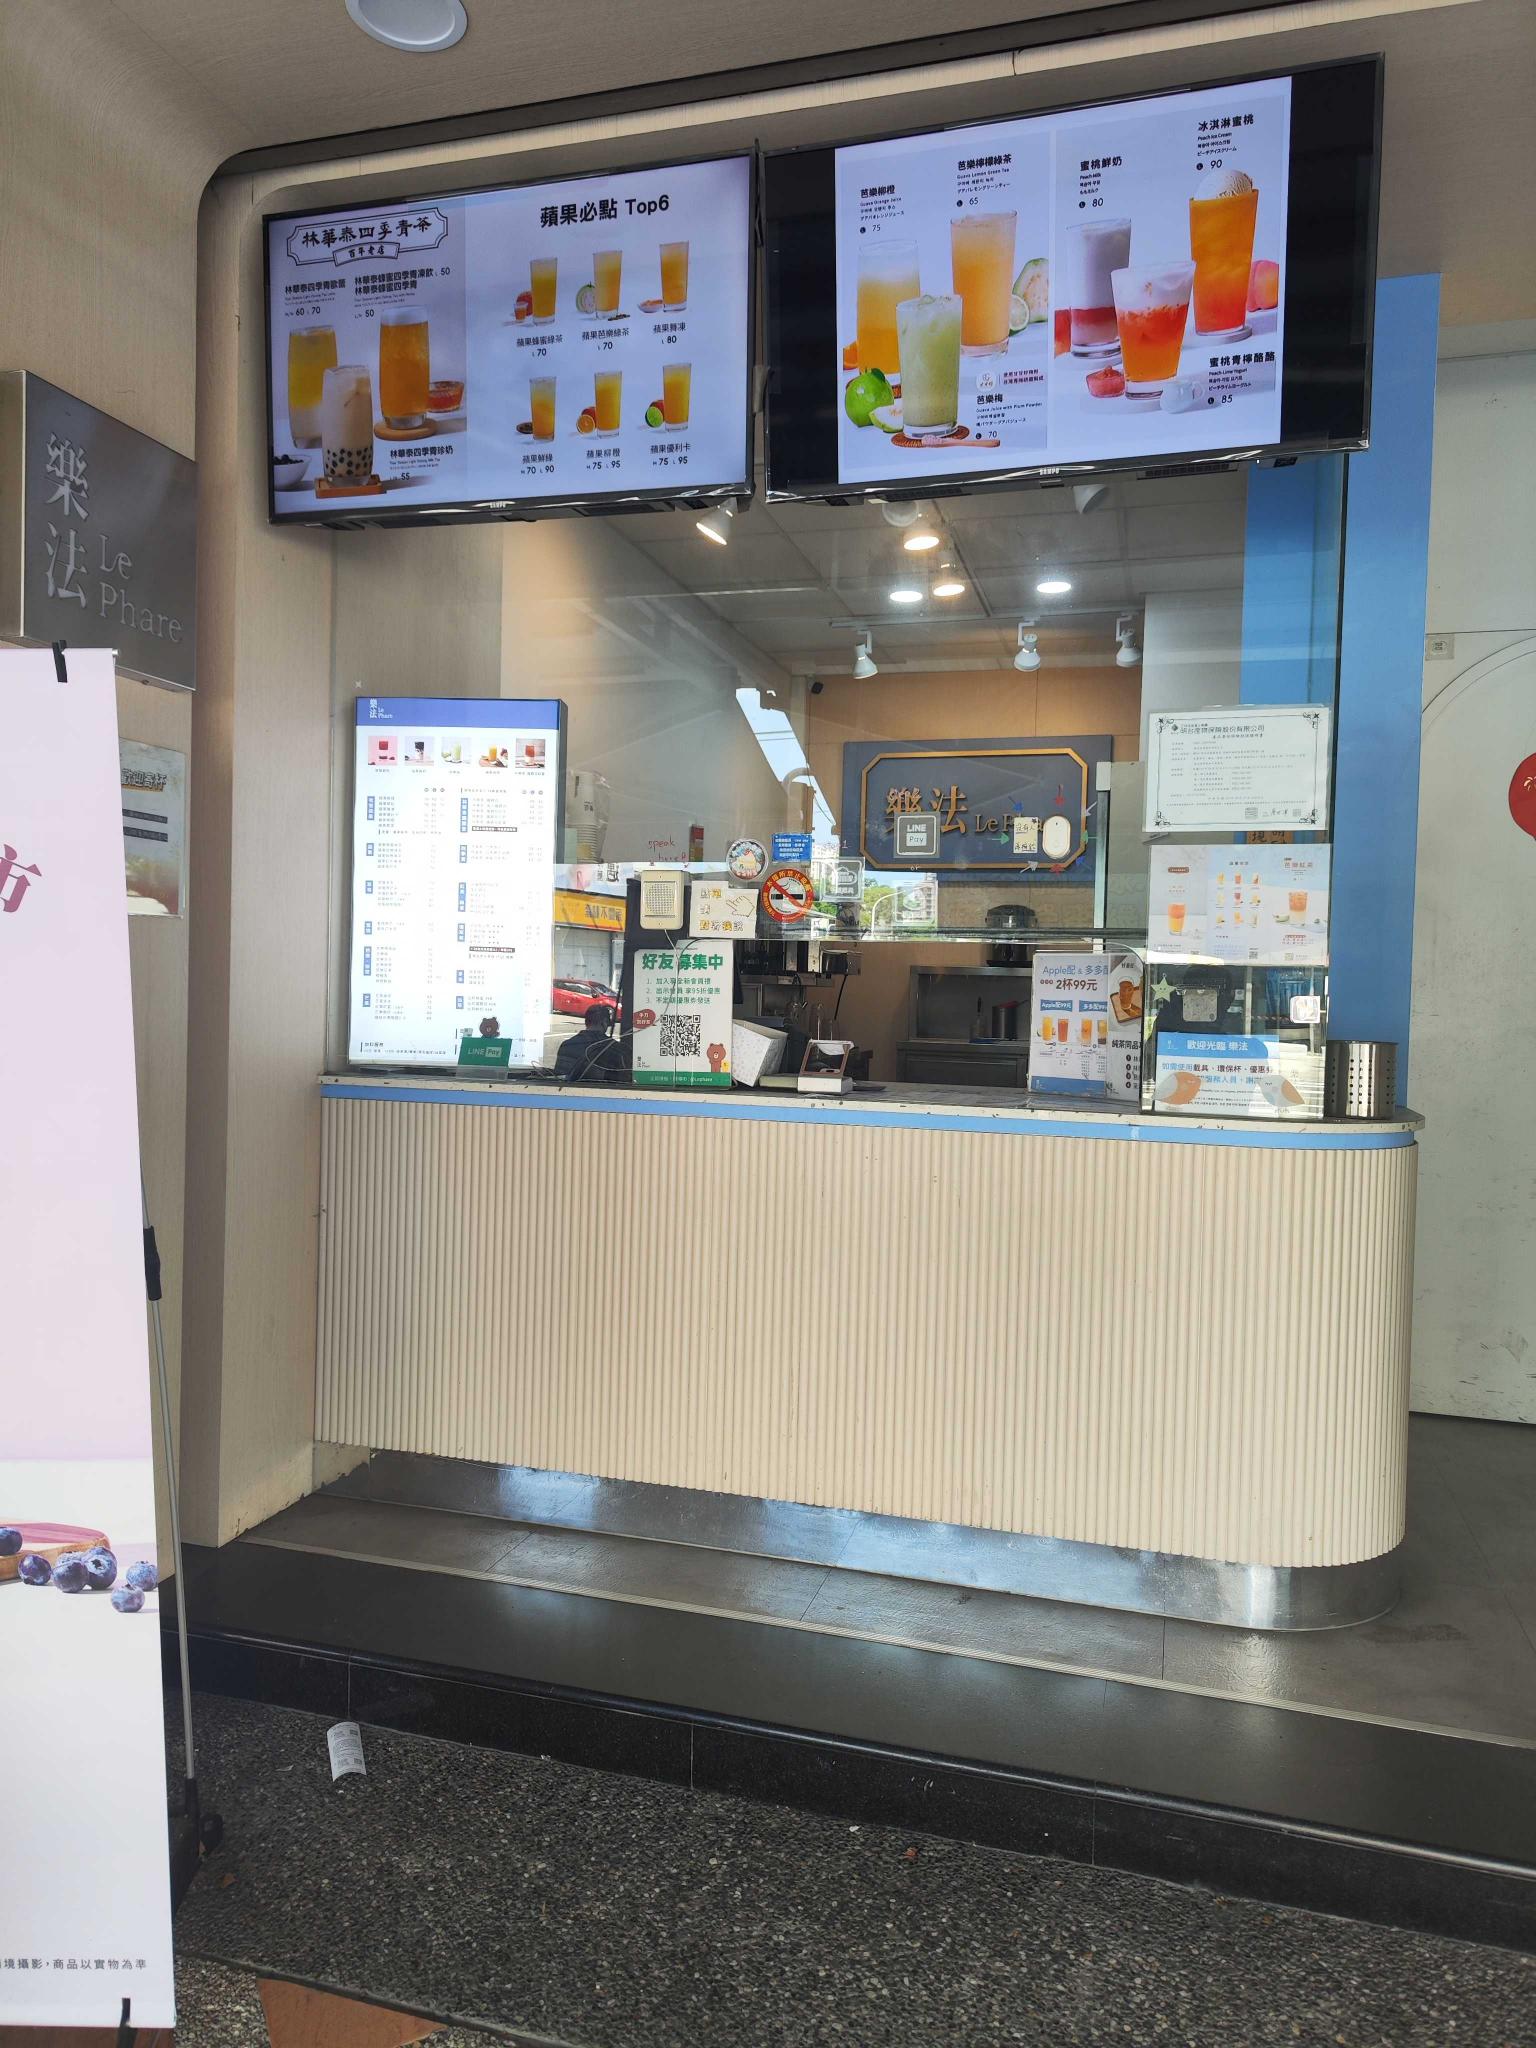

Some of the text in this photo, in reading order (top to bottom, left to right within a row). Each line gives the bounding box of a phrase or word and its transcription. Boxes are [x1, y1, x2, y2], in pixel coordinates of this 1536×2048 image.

[1198, 114, 1254, 132] 冰淇淋蜜桃
[958, 154, 1012, 171] 芭樂檸檬綠茶
[1080, 156, 1122, 171] 蜜桃鮮奶
[1210, 159, 1222, 169] 90
[860, 185, 895, 198] 芭樂柳橙
[969, 197, 979, 205] 65
[1092, 198, 1104, 207] 80
[540, 194, 669, 228] 蘋果必點 Top6
[302, 217, 432, 248] 林華泰四季青茶
[872, 224, 881, 232] 75
[349, 246, 384, 258] 百年老店
[441, 267, 450, 276] 50
[354, 279, 417, 296] 林華泰蜂蜜四季青
[296, 306, 320, 316] 60 70
[365, 309, 374, 318] 50
[582, 327, 630, 341] 蘋果芭樂綠茶
[667, 335, 677, 344] 80
[516, 334, 563, 347] 蘋果蜂蜜綠茶
[603, 342, 613, 350] 70
[537, 348, 546, 357] 70
[976, 394, 1003, 405] 芭樂梅
[1221, 394, 1233, 403] 85
[988, 430, 998, 438] 70
[390, 445, 453, 459] 林華泰四季青珍奶
[592, 461, 602, 469] 75
[611, 460, 620, 469] 95
[659, 458, 669, 466] 75
[678, 456, 688, 465] 95
[527, 466, 536, 474] 70
[545, 465, 554, 473] 90
[401, 473, 410, 481] 55
[44, 432, 90, 608] 樂法
[99, 534, 133, 579] Le
[99, 582, 182, 643] Phare
[907, 824, 926, 832] LINE
[976, 815, 998, 833] Le
[648, 835, 675, 852] speak
[909, 835, 924, 844] Pay
[642, 953, 723, 971] 好友募集中
[1043, 965, 1076, 977] Apple配
[1056, 978, 1098, 991] 2杯99元
[1187, 1040, 1248, 1051] 歡迎光臨 樂法
[468, 1047, 485, 1056] LINE
